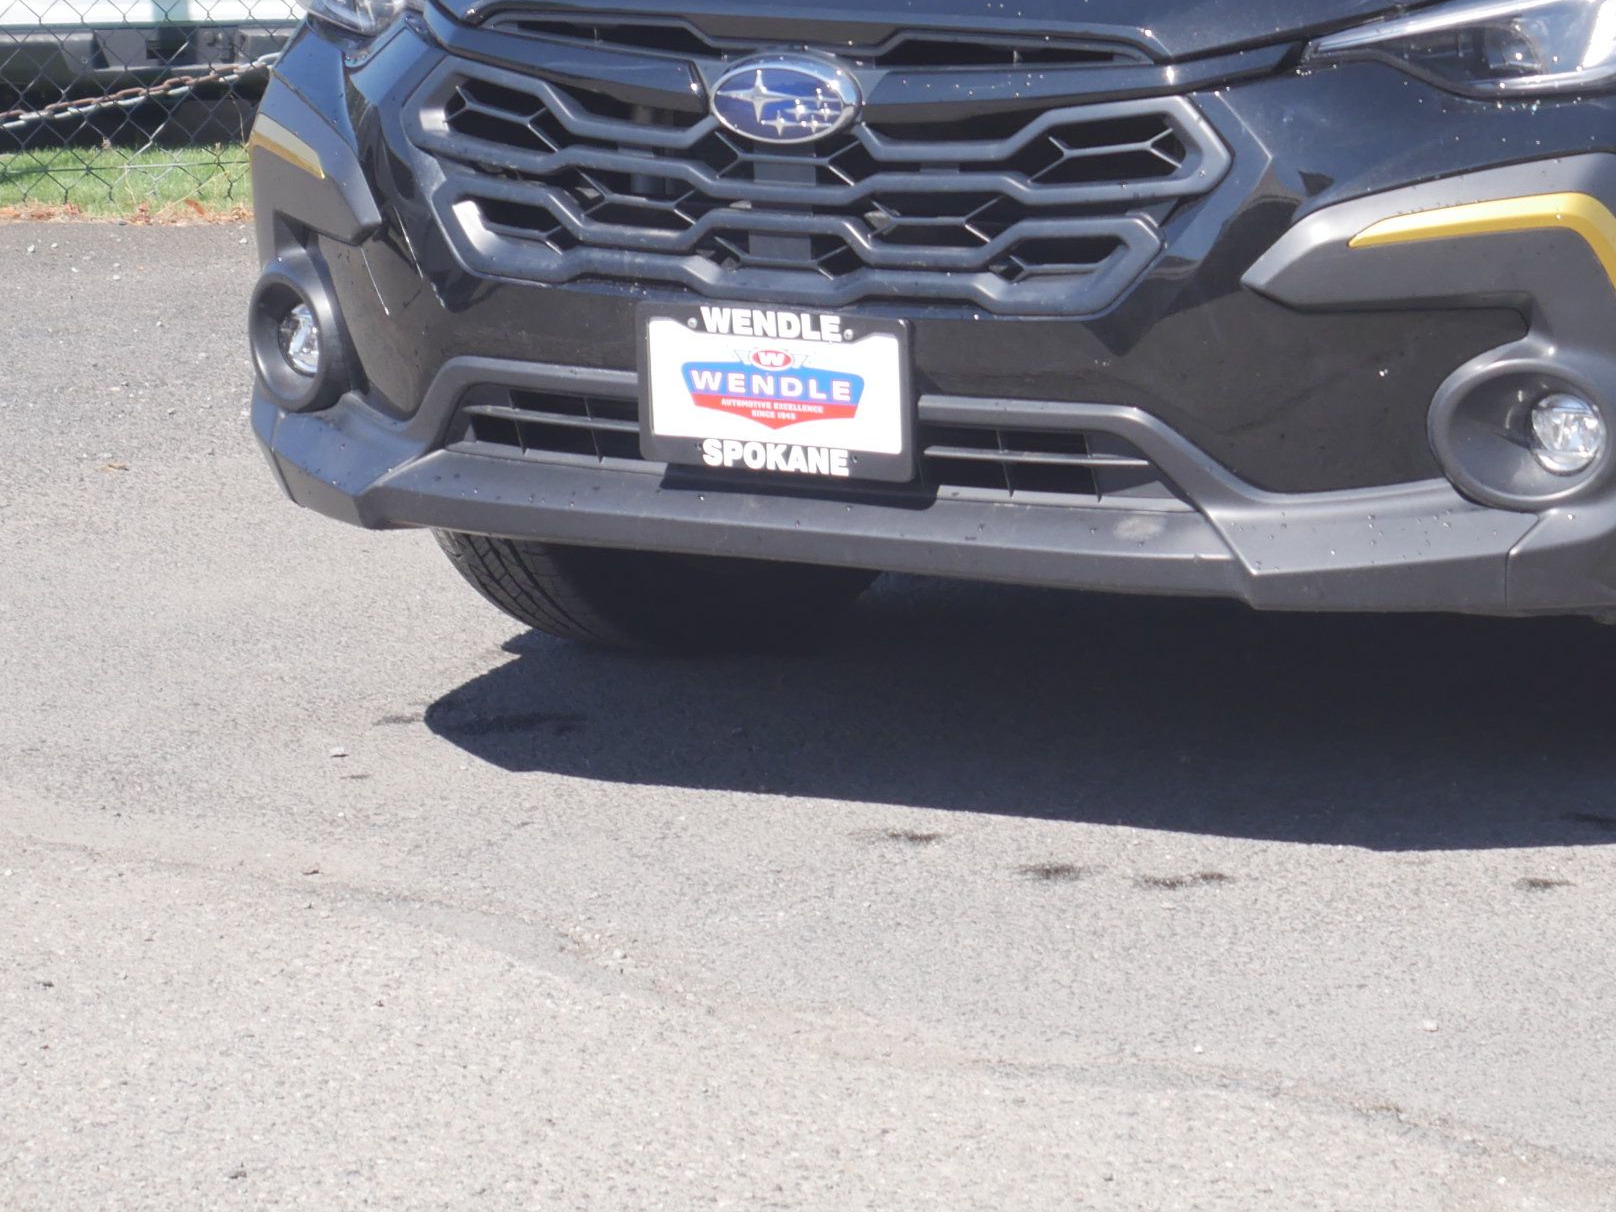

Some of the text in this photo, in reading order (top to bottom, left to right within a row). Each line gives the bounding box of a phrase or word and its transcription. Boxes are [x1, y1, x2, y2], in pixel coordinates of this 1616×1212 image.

[700, 306, 842, 342] WENDLE
[690, 369, 851, 401] WENDLE
[721, 398, 823, 413] AUTOMOTIVE EXCELLENCE
[751, 409, 775, 419] SINCE
[702, 439, 849, 476] SPOKANE
